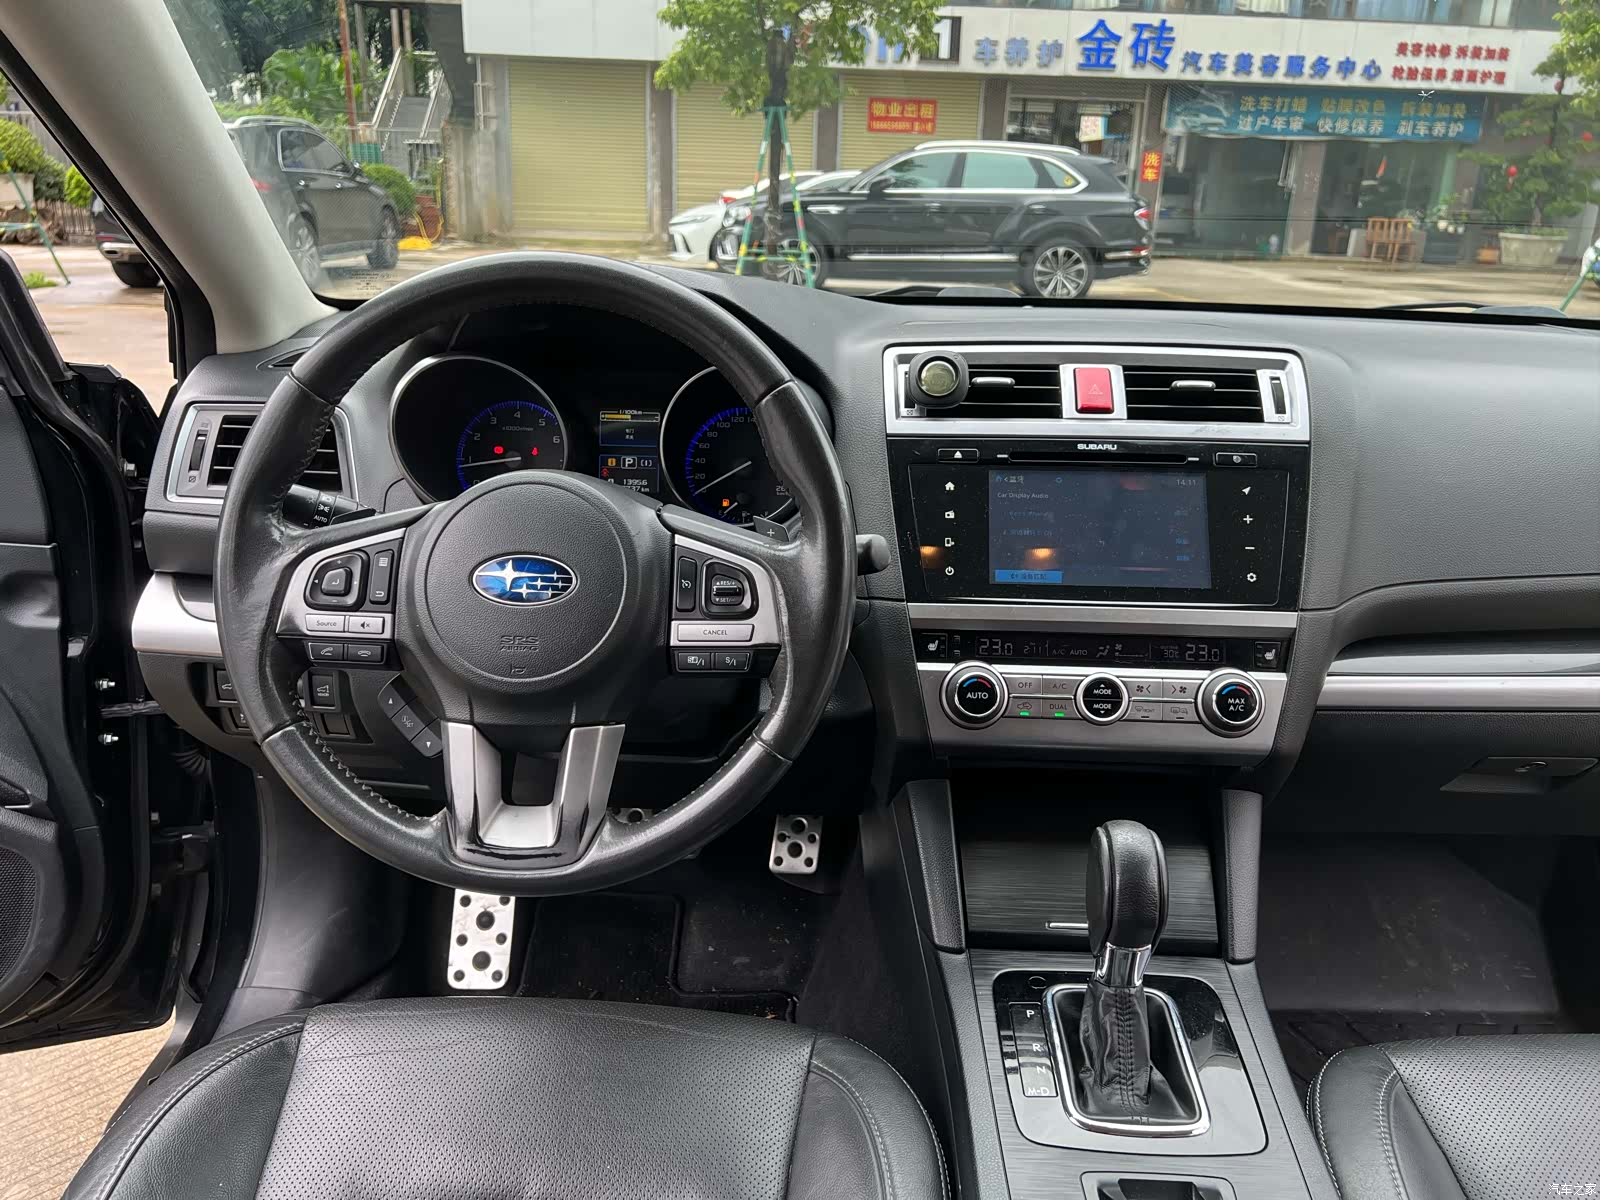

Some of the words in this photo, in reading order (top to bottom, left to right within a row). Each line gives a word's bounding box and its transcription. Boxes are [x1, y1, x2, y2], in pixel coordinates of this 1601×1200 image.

[1077, 18, 1177, 71] 金砖
[974, 37, 1064, 67] 车养护
[1182, 51, 1382, 79] 汽车美容服务中心
[871, 102, 935, 119] 物业出租
[1237, 114, 1305, 133] 过户年审
[1317, 116, 1385, 135] 快修保养
[1397, 119, 1465, 138] 刹车养护
[1143, 152, 1161, 182] 洗车
[490, 416, 497, 424] 3
[538, 418, 546, 426] 5
[473, 432, 481, 440] 2
[552, 435, 561, 444] 6
[1077, 443, 1118, 451] SUBARU
[1009, 492, 1030, 500] Display
[313, 514, 328, 524] AUTO
[500, 635, 539, 645] SRS
[978, 638, 1013, 656] 23.0
[1069, 648, 1088, 656] AUTO
[1185, 643, 1220, 662] 23.0
[1017, 681, 1033, 689] OFF
[1052, 682, 1067, 690] A/C
[966, 691, 989, 700] AUTO
[1049, 703, 1068, 711] DUAL
[1228, 704, 1245, 712] A/C
[1026, 1009, 1035, 1018] P
[1032, 1043, 1041, 1052] R
[1036, 1066, 1046, 1074] N
